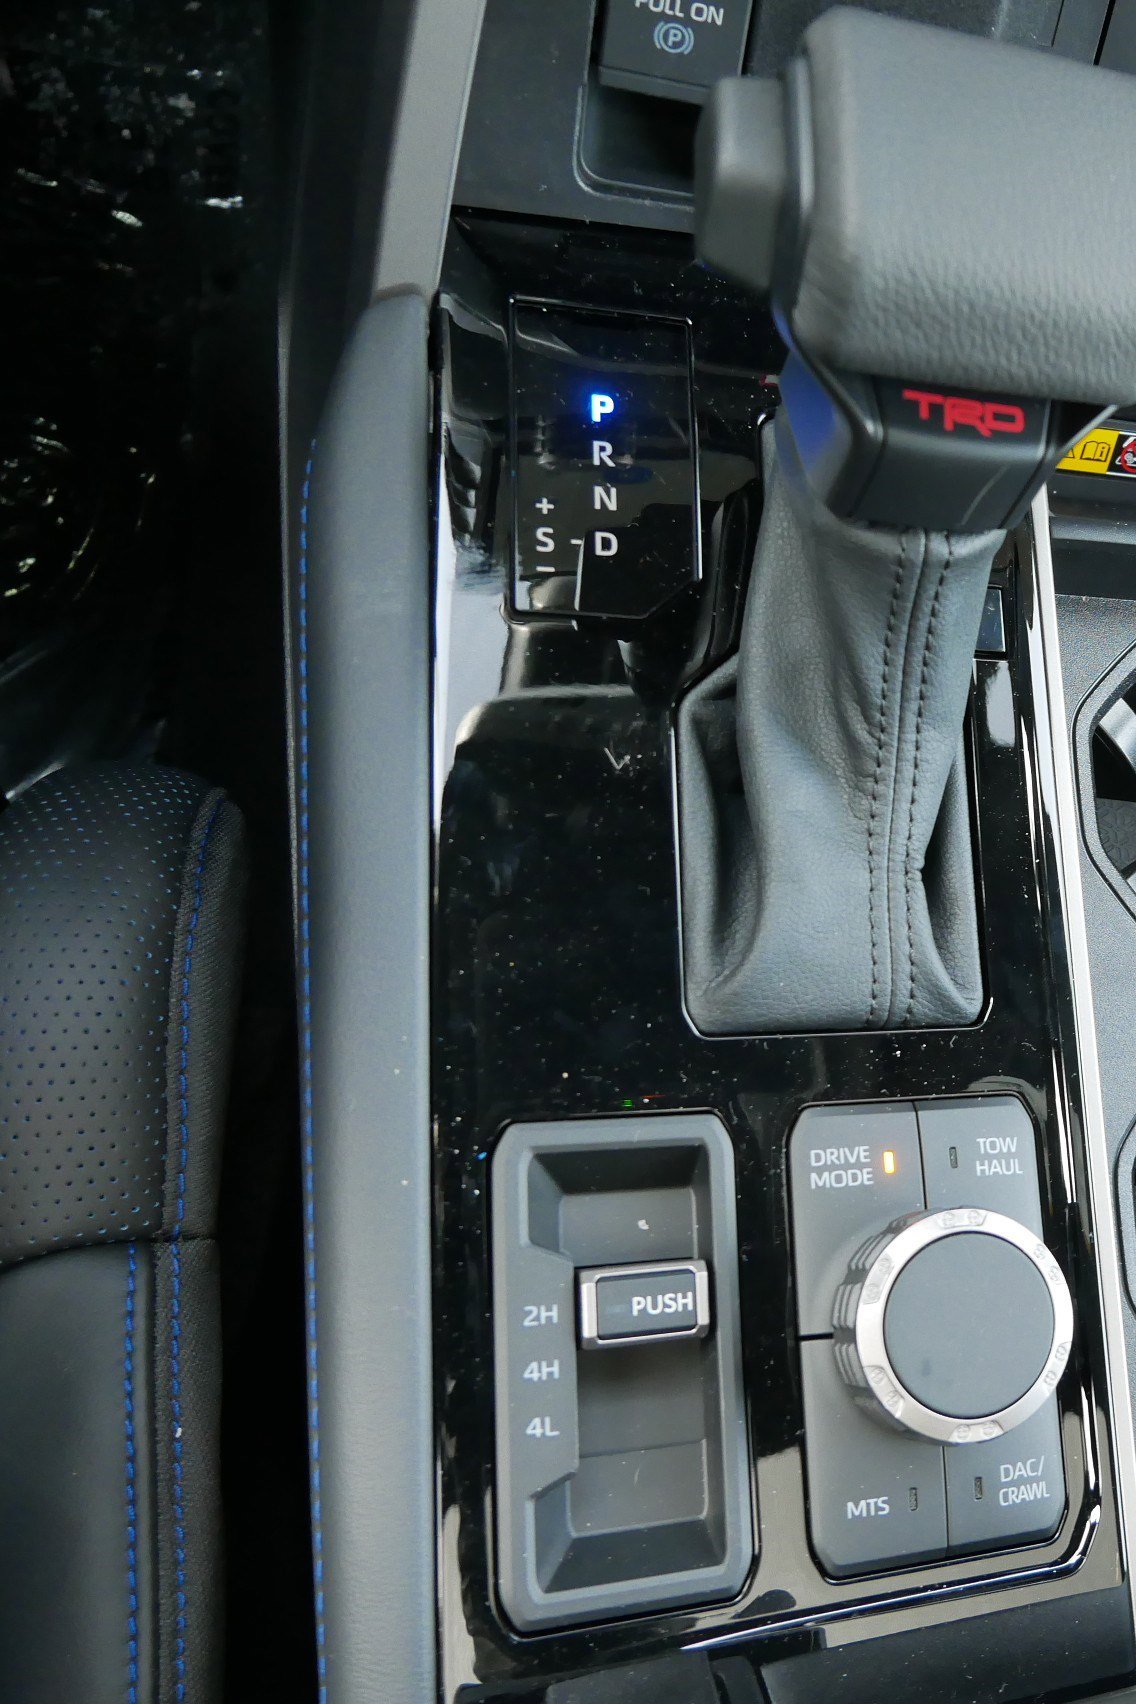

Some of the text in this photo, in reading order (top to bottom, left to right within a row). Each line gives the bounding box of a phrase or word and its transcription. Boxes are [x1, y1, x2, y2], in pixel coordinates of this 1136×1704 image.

[690, 2, 725, 26] ON
[590, 393, 615, 422] P
[902, 388, 1026, 438] TRD
[592, 440, 616, 467] R
[593, 485, 618, 511] N
[535, 527, 555, 553] S
[594, 531, 619, 557] D
[810, 1146, 871, 1167] DRIVE
[976, 1137, 1018, 1155] TOW
[810, 1167, 874, 1189] MODE
[976, 1159, 1024, 1177] HAUL
[522, 1303, 559, 1328] 2H
[631, 1291, 694, 1317] PUSH
[522, 1358, 560, 1382] 4H
[525, 1416, 560, 1439] 4L
[1000, 1455, 1045, 1482] DAC/
[999, 1480, 1051, 1507] CRAWL
[846, 1496, 890, 1519] MTS
